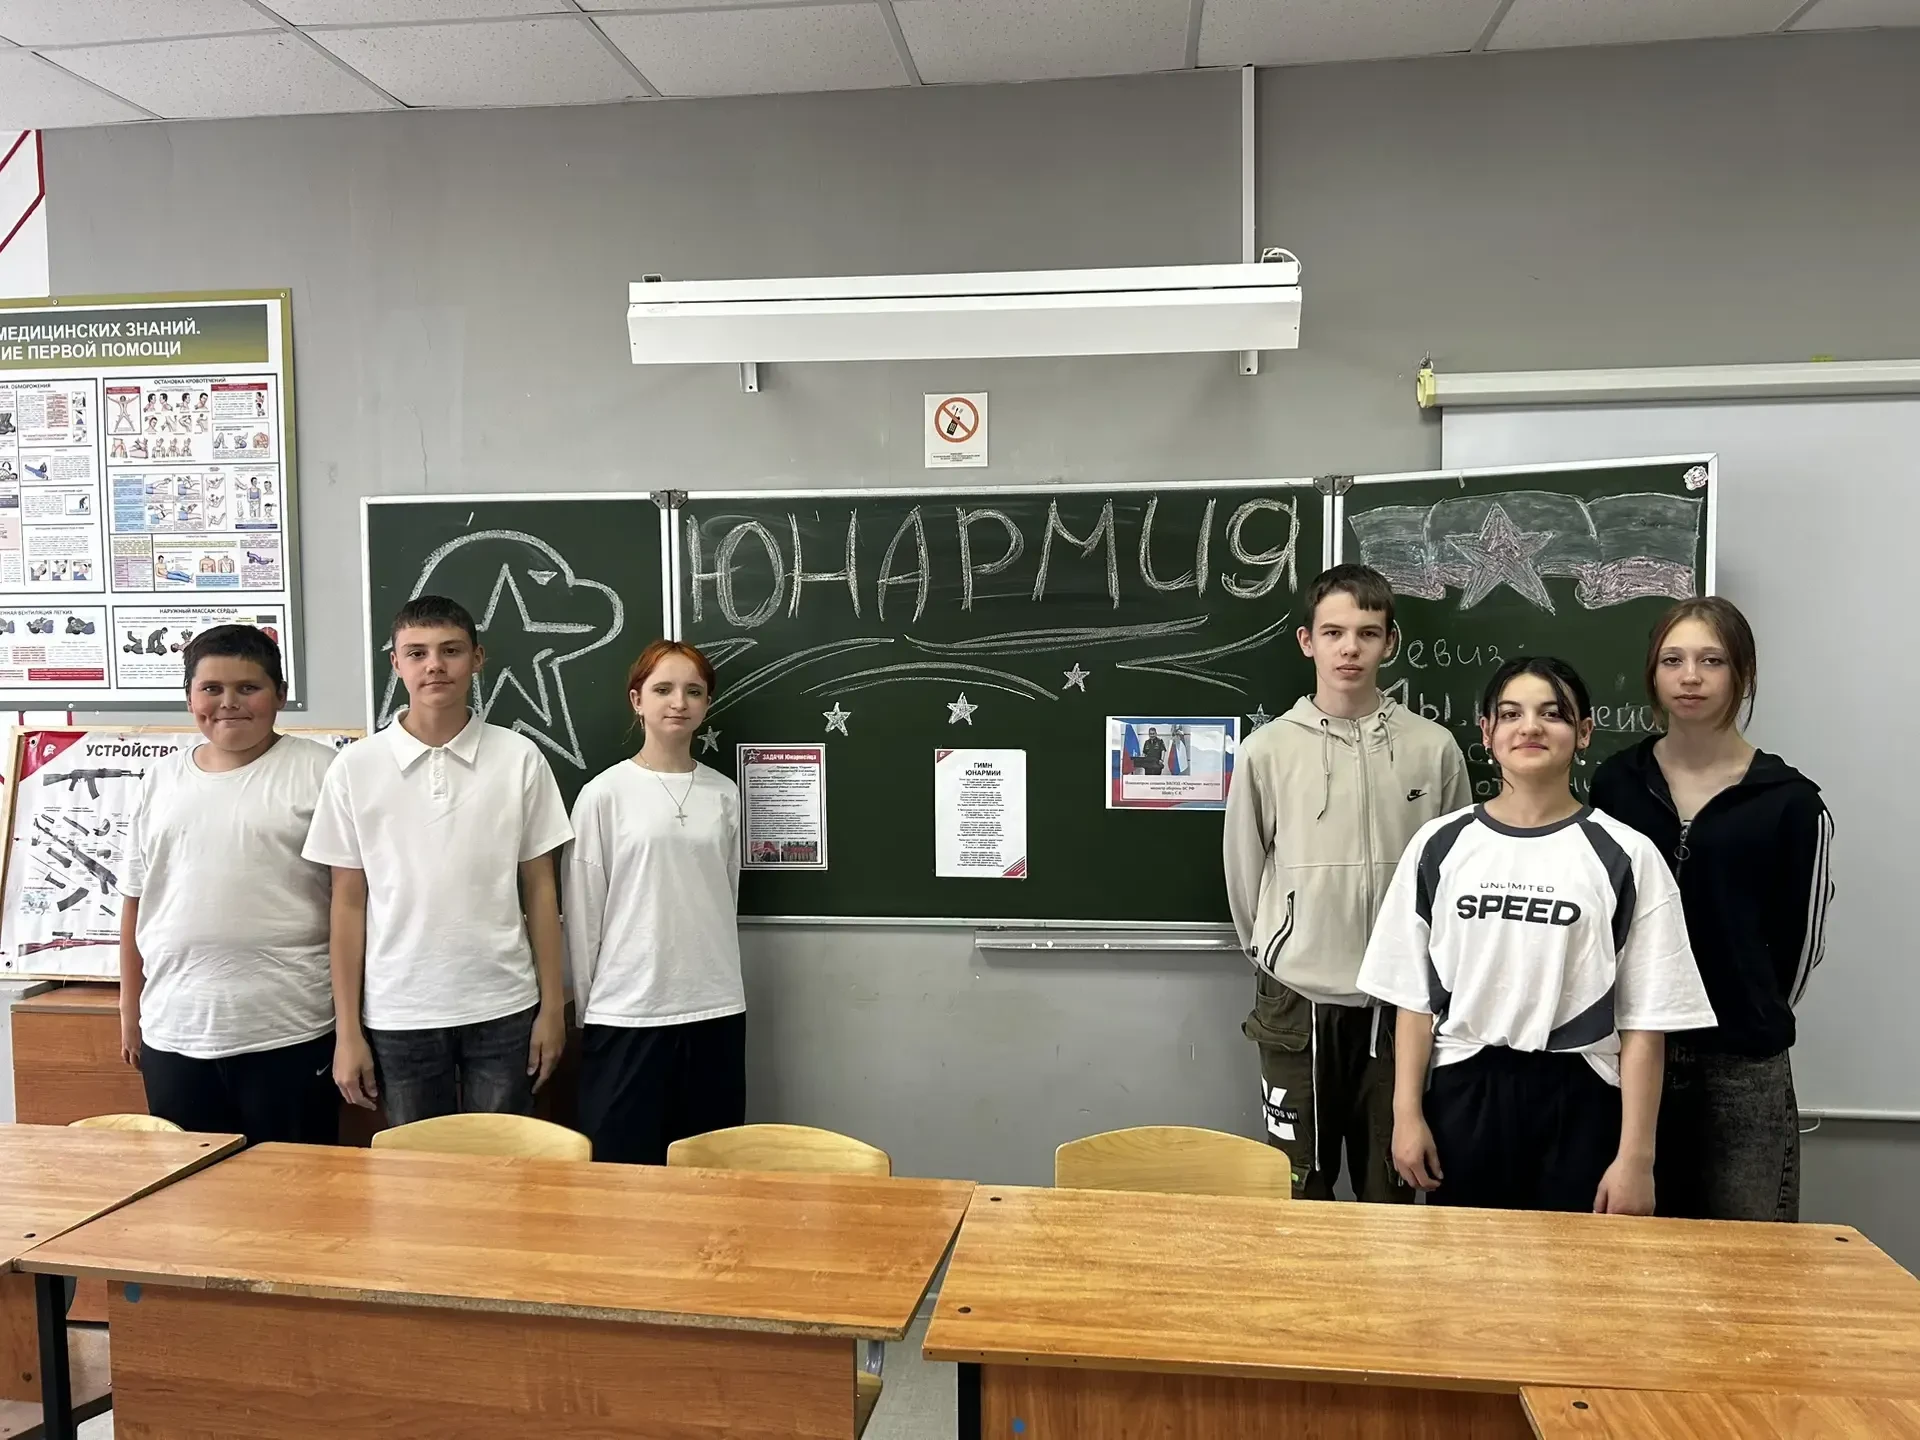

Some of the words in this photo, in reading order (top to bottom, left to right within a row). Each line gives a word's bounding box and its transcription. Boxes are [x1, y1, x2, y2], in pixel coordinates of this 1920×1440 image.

[126, 317, 201, 337] ЗНАНИЙ.
[27, 341, 97, 360] ПЕРВОЙ
[101, 340, 182, 358] ПОМОЩИ
[685, 491, 1301, 631] ЮНАРМИЯ
[762, 753, 784, 761] ЗАДАЧИ
[1479, 882, 1555, 893] UNLIMITED
[1456, 894, 1582, 927] SPEED
